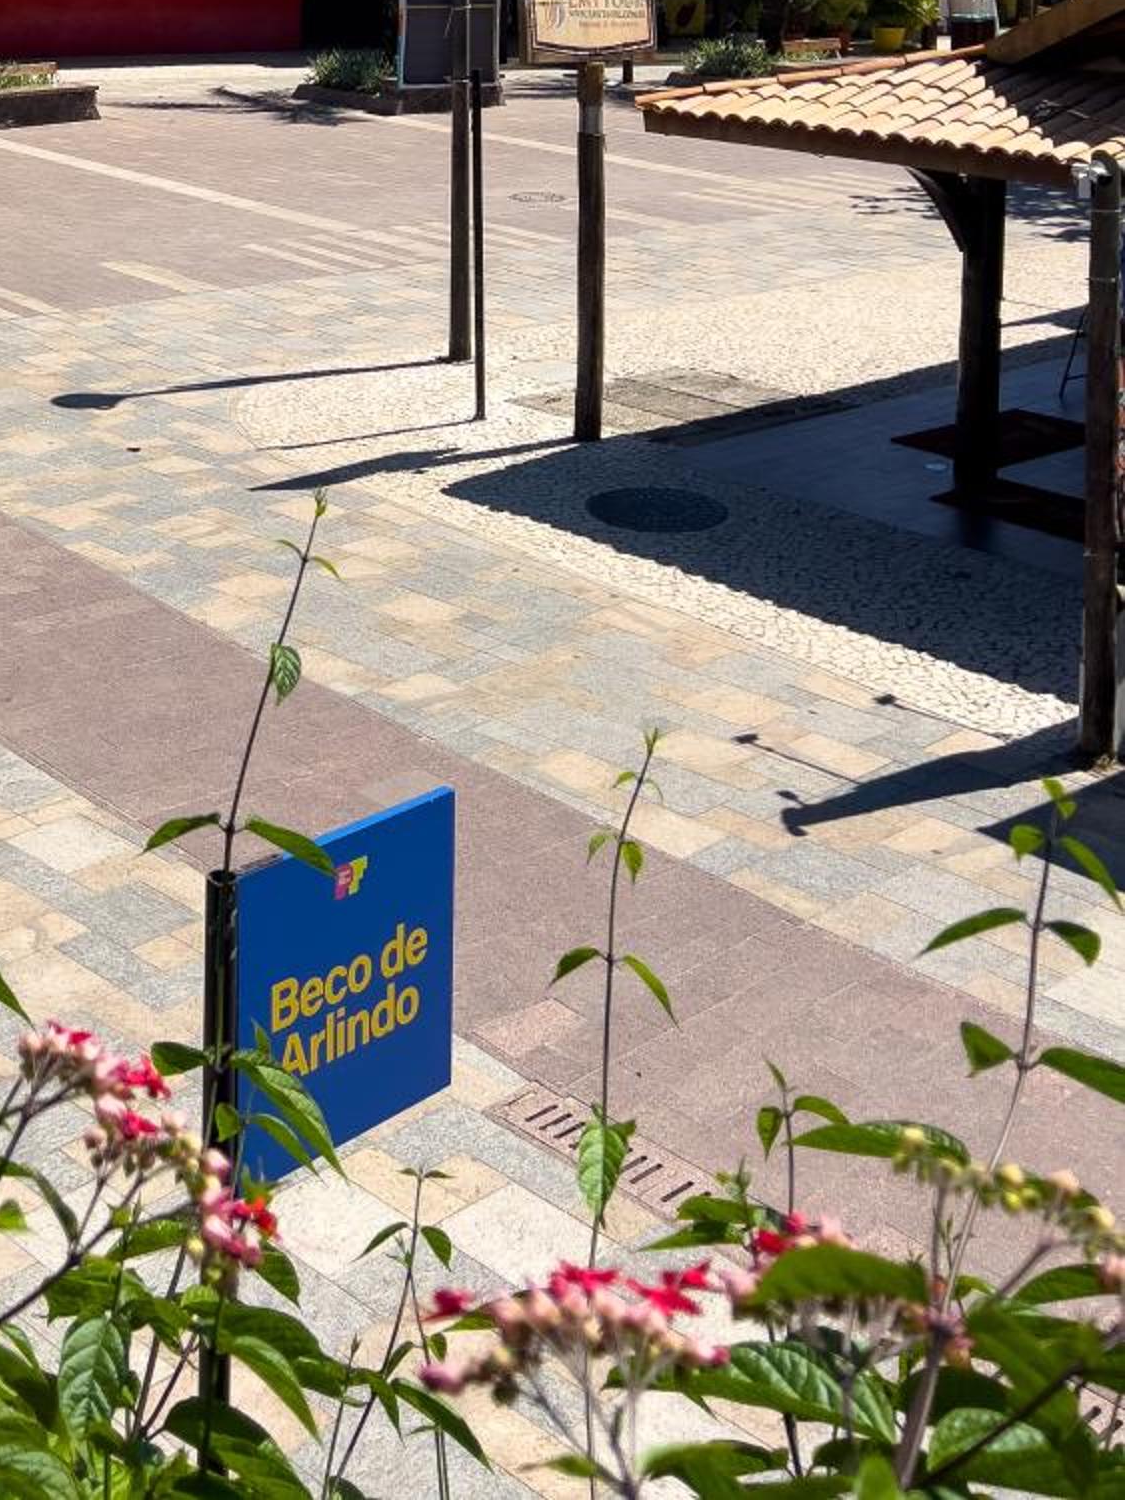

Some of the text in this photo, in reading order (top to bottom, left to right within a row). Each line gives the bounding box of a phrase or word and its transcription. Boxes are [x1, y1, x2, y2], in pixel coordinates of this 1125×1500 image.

[271, 922, 428, 1033] Beco de
[281, 982, 420, 1077] Arlindo
